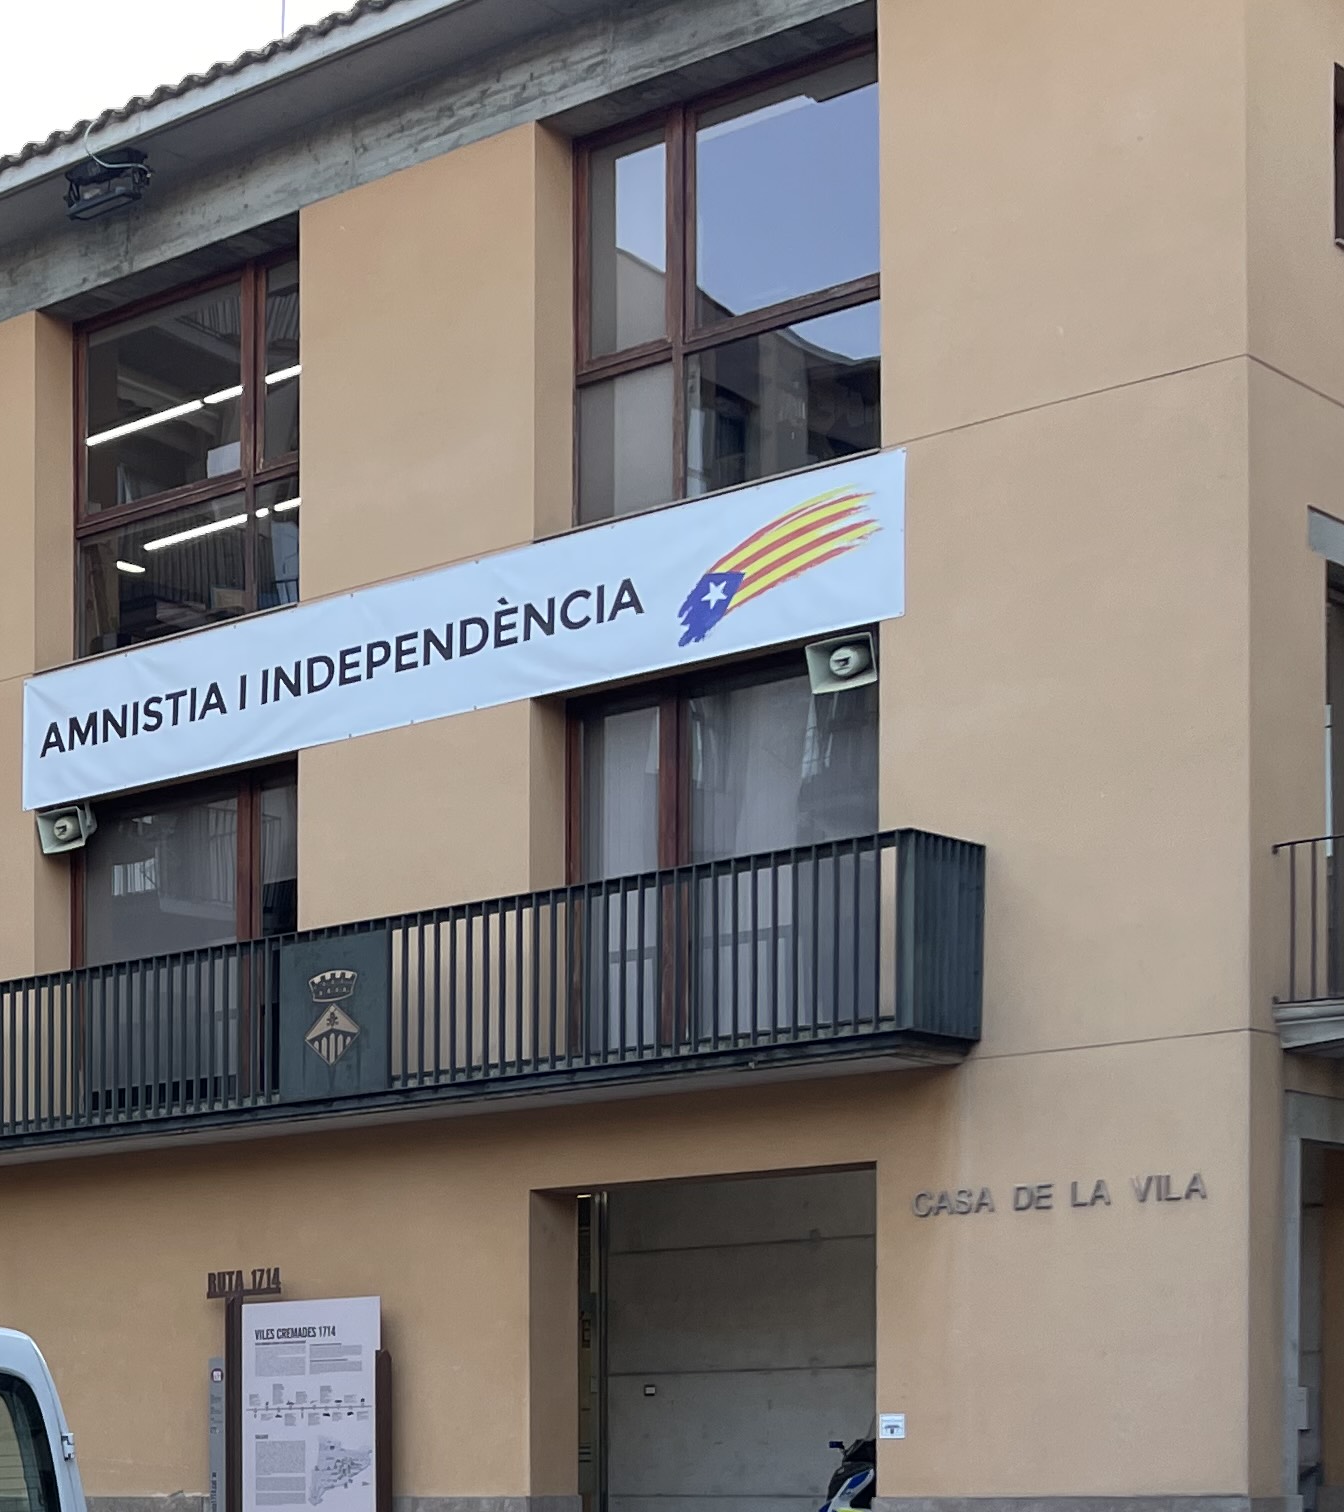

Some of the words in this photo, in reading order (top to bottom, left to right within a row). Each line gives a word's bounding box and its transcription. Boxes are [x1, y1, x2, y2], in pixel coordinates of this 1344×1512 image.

[40, 680, 228, 760] AMNISTIA
[239, 673, 248, 712] I
[261, 577, 645, 706] INDEPENDÈNCIA
[911, 1187, 995, 1218] CASA
[1013, 1183, 1054, 1211] DE
[1070, 1179, 1111, 1208] LA
[1131, 1173, 1208, 1203] VILA
[208, 1270, 244, 1293] RUTA
[250, 1267, 282, 1290] 1714
[255, 1329, 275, 1341] VILES
[276, 1326, 317, 1339] CREMADES
[318, 1325, 336, 1337] 1714
